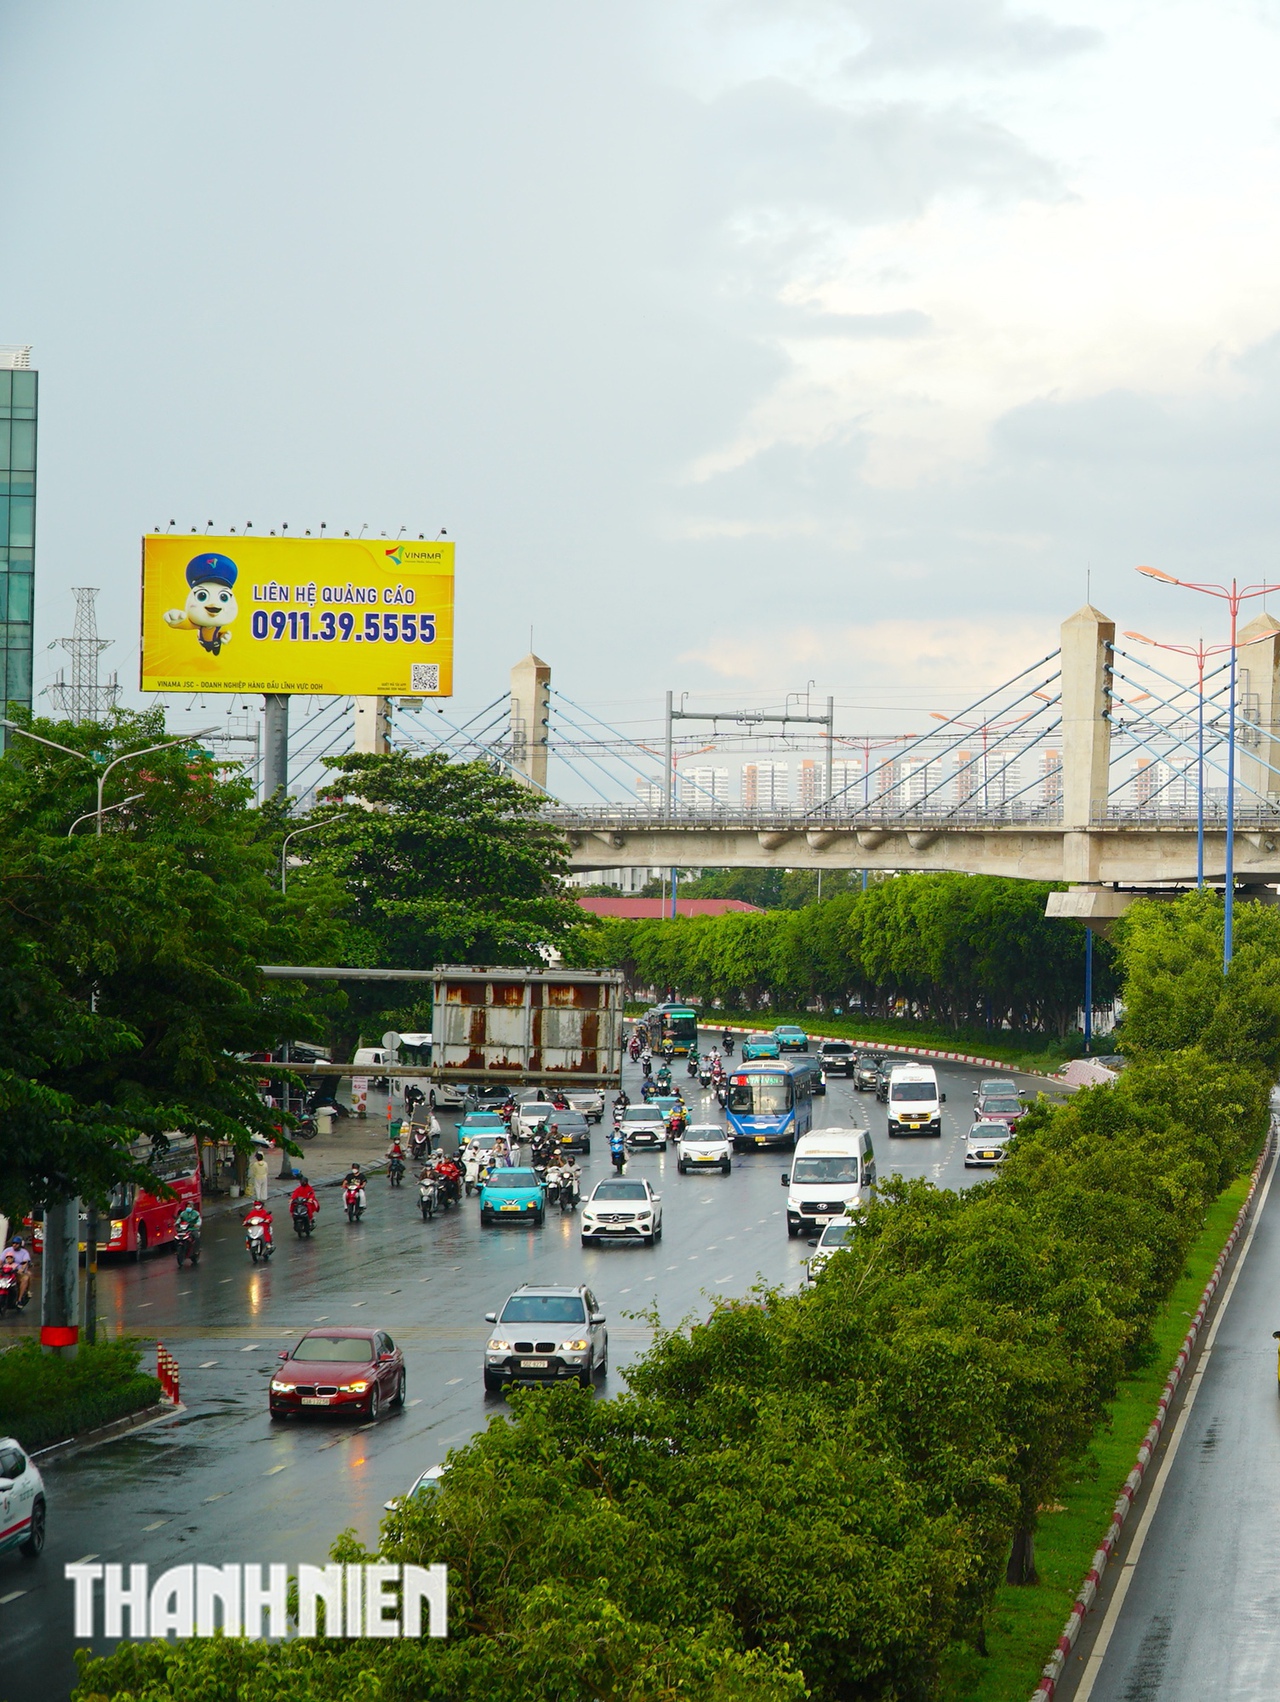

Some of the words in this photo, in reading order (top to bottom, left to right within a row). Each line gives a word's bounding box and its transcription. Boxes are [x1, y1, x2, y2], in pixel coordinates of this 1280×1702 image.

[404, 552, 442, 560] VINAMA
[253, 580, 290, 602] LIÊN
[295, 583, 317, 607] HỆ
[321, 583, 378, 604] QUẢNG
[383, 585, 415, 605] CÁO
[251, 609, 437, 644] 0911.39.5555
[156, 680, 181, 688] VINAMA
[200, 681, 222, 689] DOANH
[223, 680, 247, 690] NGHIỆP
[248, 681, 265, 689] HÀNG
[280, 681, 295, 690] LĨNH
[296, 682, 310, 690] VỰC
